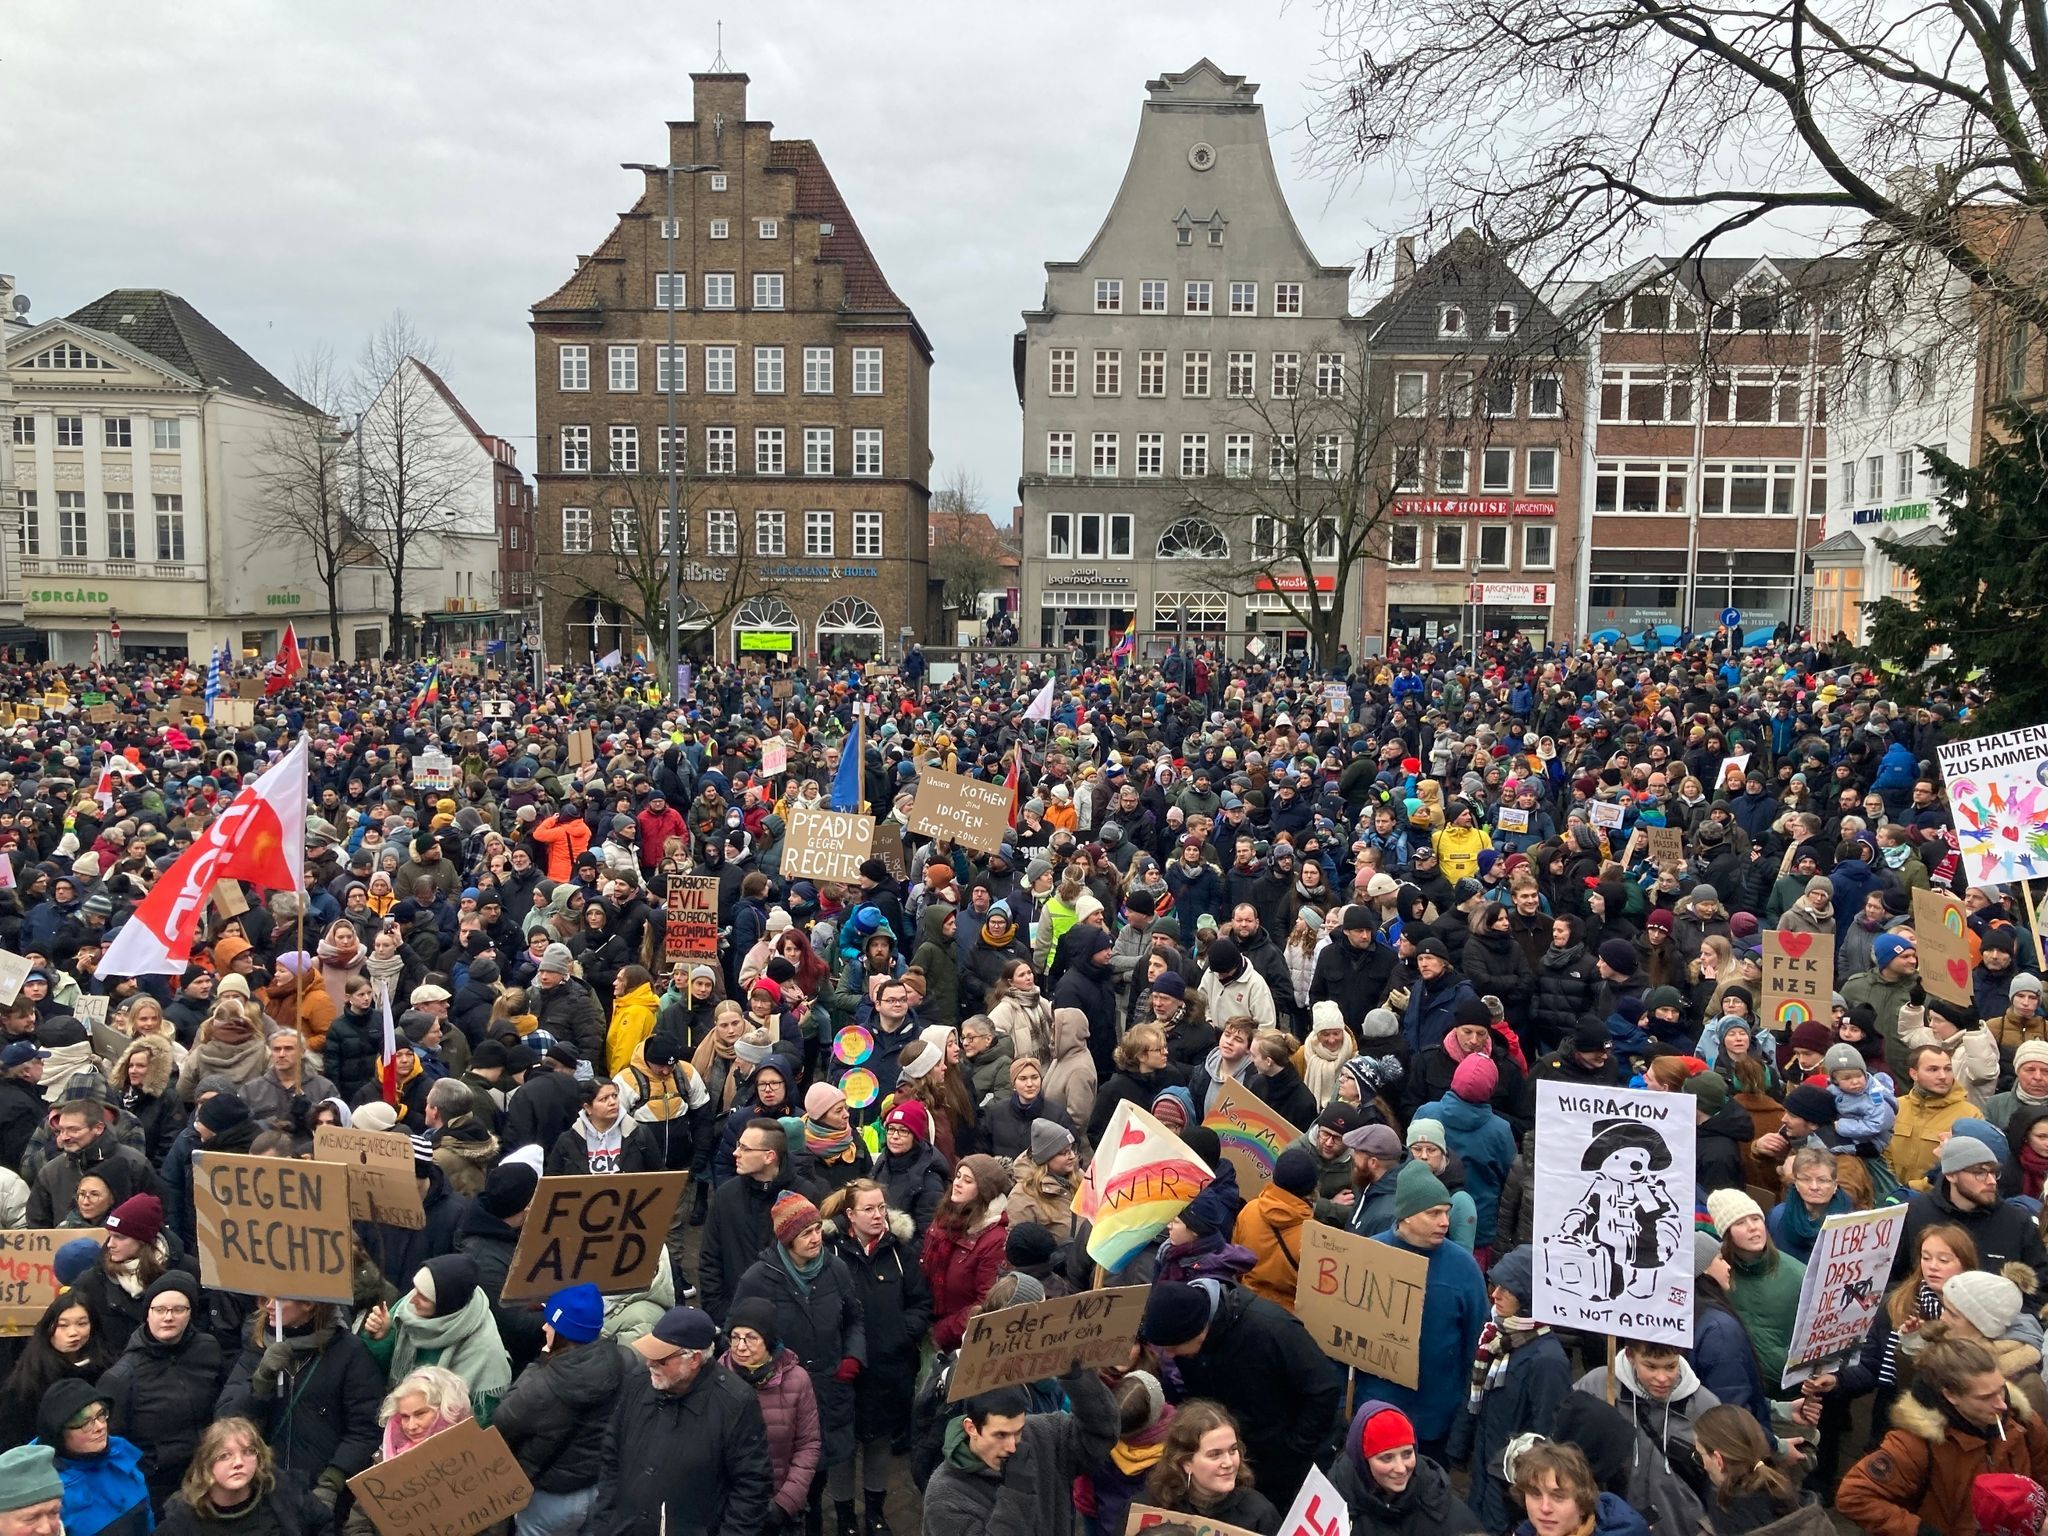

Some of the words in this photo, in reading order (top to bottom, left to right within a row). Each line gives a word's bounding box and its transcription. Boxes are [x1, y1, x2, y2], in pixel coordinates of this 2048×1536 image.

[1396, 501, 1442, 513] STEAK
[1458, 501, 1506, 513] HOUSE
[1514, 503, 1554, 514] ARGENTINA
[831, 566, 841, 579] &
[844, 567, 877, 577] HOECK
[1071, 568, 1098, 577] salon
[31, 588, 109, 602] SØRGÅRD
[1485, 585, 1529, 593] ARGENTINA
[1938, 742, 1972, 760] WIR
[1977, 726, 2048, 752] HALTEN
[1945, 743, 2048, 777] ZUSAMMEN
[927, 776, 950, 789] Unsere
[960, 783, 1007, 807] KOTHEN
[791, 812, 870, 842] PFADIS
[1654, 829, 1673, 840] ALLE
[808, 837, 844, 850] GEGEN
[784, 848, 866, 879] RECHTS
[668, 890, 709, 910] EVIL
[687, 912, 717, 925] BECOME
[667, 939, 683, 949] TO
[1772, 977, 1816, 995] NZS
[76, 998, 105, 1016] EKEL
[1558, 1095, 1668, 1121] MIGRATION
[319, 1135, 410, 1160] MENSCHENRECHTE
[589, 1154, 622, 1172] CK
[210, 1165, 322, 1212] GEGEN
[350, 1169, 385, 1189] TATT
[1104, 1167, 1179, 1210] WIR
[542, 1187, 664, 1235] FCK
[220, 1218, 345, 1275] RECHTS
[1830, 1222, 1871, 1259] LEBE
[525, 1232, 647, 1283] AFD
[1824, 1260, 1864, 1288] DASS
[1312, 1257, 1422, 1325] BUNT
[1817, 1288, 1841, 1313] DIE
[972, 1317, 992, 1344] In
[1005, 1308, 1054, 1334] der
[1069, 1294, 1123, 1324] NOT
[1553, 1304, 1567, 1318] IS
[1580, 1307, 1613, 1323] NOT
[1619, 1312, 1633, 1327] A
[1636, 1314, 1686, 1332] CRIME
[1806, 1316, 1874, 1346] DAGEGEN
[1812, 1312, 1839, 1330] WAS
[1041, 1331, 1070, 1348] nur
[1076, 1323, 1103, 1339] ein
[1327, 1324, 1399, 1374] BRAUN
[362, 1450, 477, 1511] Rassisten
[388, 1493, 442, 1528] sind
